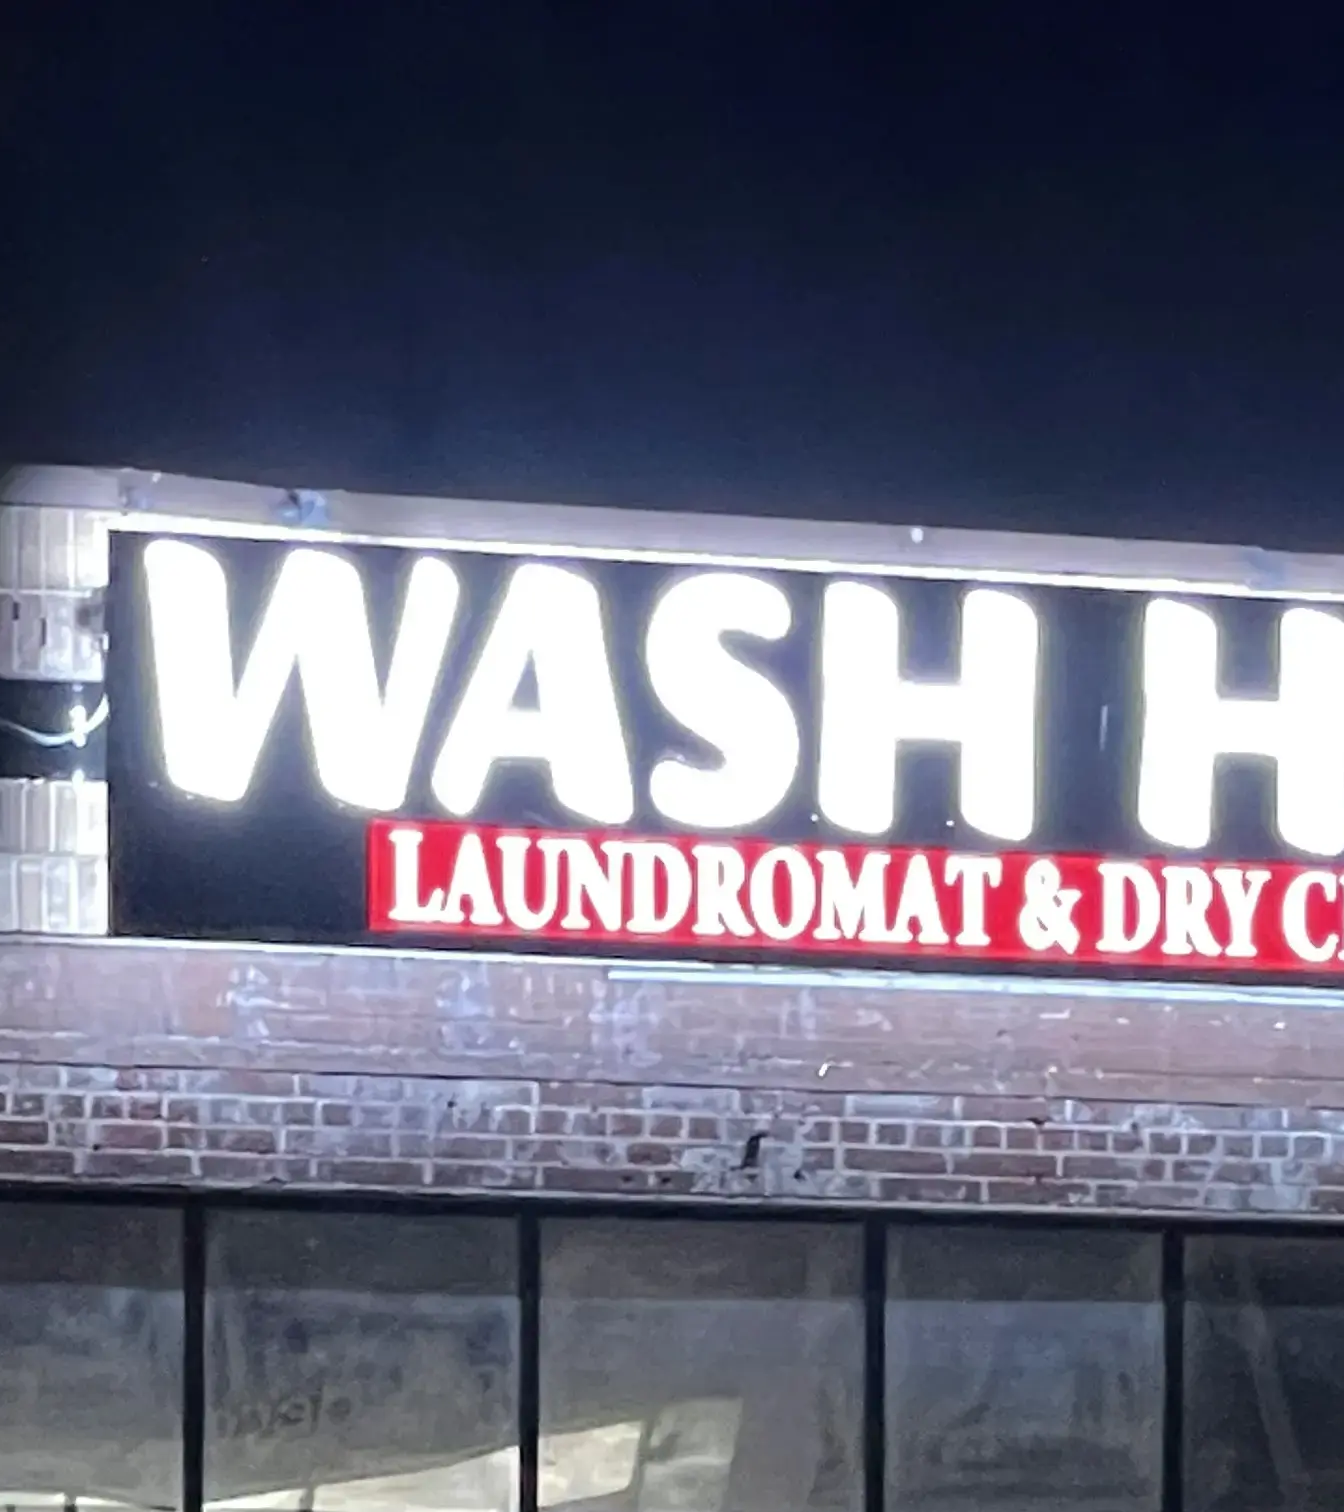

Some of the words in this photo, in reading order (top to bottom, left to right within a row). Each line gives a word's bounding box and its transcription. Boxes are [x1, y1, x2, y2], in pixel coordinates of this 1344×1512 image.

[143, 539, 1039, 842] WASH
[388, 829, 1002, 947] LAUNDROMAT
[1018, 859, 1080, 957] &
[1098, 862, 1272, 959] DRY
